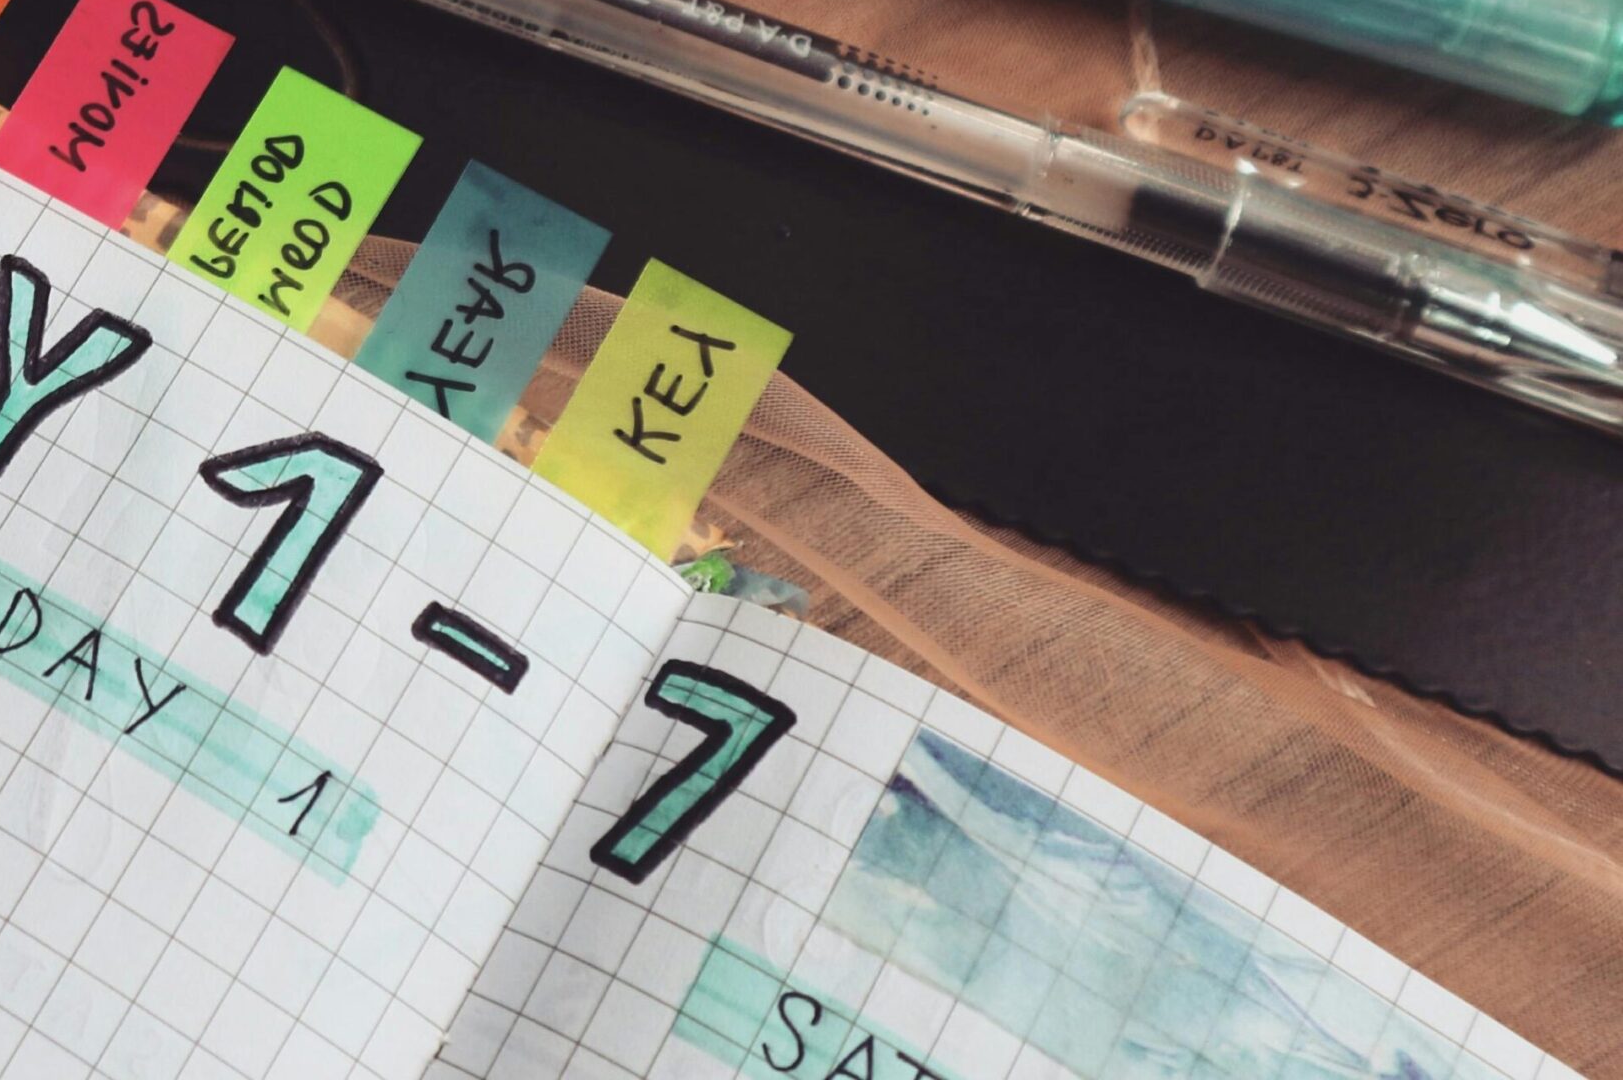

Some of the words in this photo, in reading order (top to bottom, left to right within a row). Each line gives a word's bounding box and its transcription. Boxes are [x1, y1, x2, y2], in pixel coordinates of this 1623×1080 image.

[199, 433, 384, 656] 1
[589, 659, 797, 885] 7
[277, 770, 332, 836] 1
